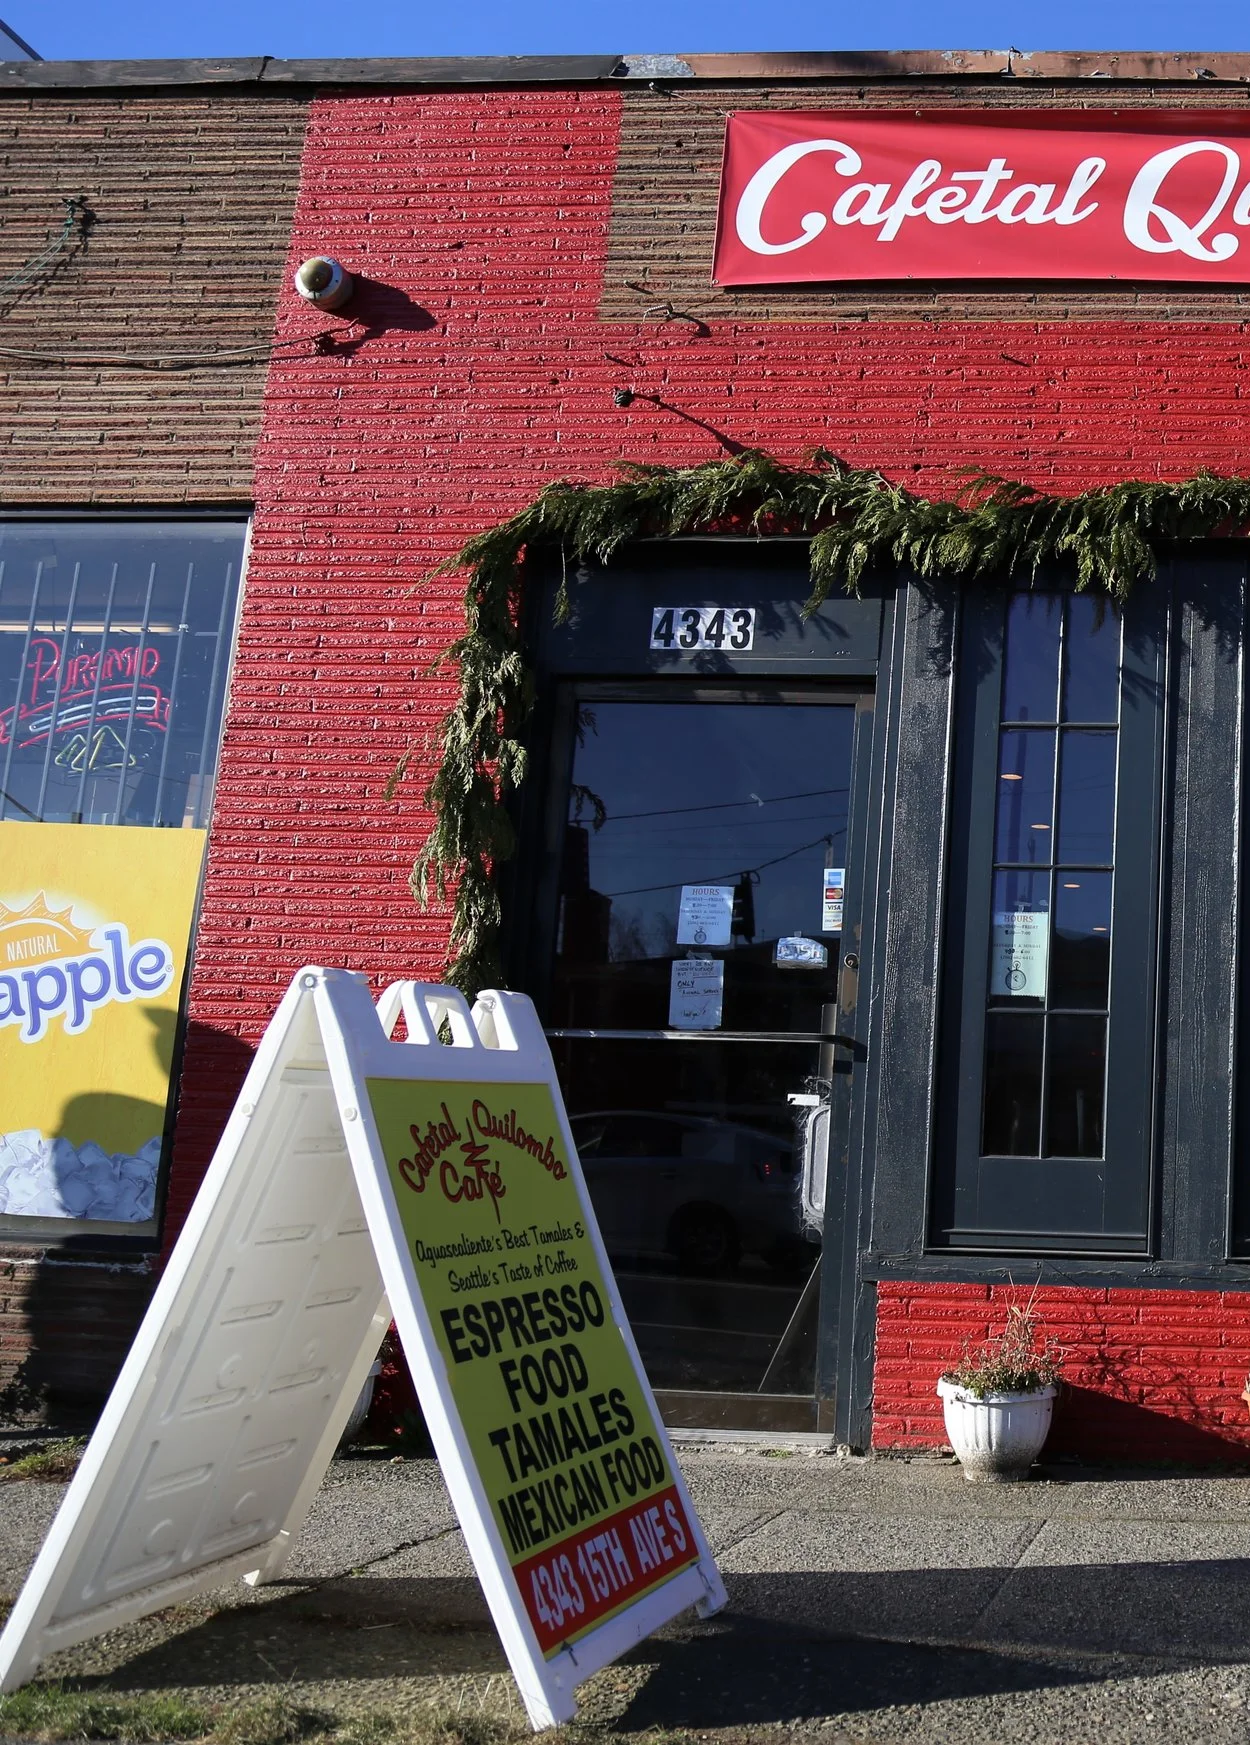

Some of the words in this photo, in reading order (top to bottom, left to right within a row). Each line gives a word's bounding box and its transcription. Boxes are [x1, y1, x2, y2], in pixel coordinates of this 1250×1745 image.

[734, 138, 1107, 256] Cafetal
[653, 608, 752, 649] 4343
[6, 934, 61, 962] NATURAL
[399, 1102, 461, 1193] Cafetal
[472, 1099, 567, 1180] Quilombo
[415, 1233, 501, 1268] Aguascaliente's
[501, 1229, 530, 1249] Best
[529, 1221, 573, 1245] Tamales
[575, 1221, 585, 1238] &
[448, 1270, 499, 1292] Seattle's
[499, 1262, 532, 1283] Taste
[534, 1254, 544, 1276] of
[544, 1250, 578, 1274] Coffee
[440, 1280, 604, 1364] ESPRESSO
[500, 1343, 589, 1413] FOOD
[488, 1388, 635, 1483] TAMALES
[498, 1460, 609, 1554] MEXICAN
[600, 1436, 665, 1503] FOOD
[530, 1553, 585, 1631] 4343
[577, 1528, 634, 1602] 15TH
[629, 1506, 674, 1574] AVE
[664, 1499, 687, 1551] S
